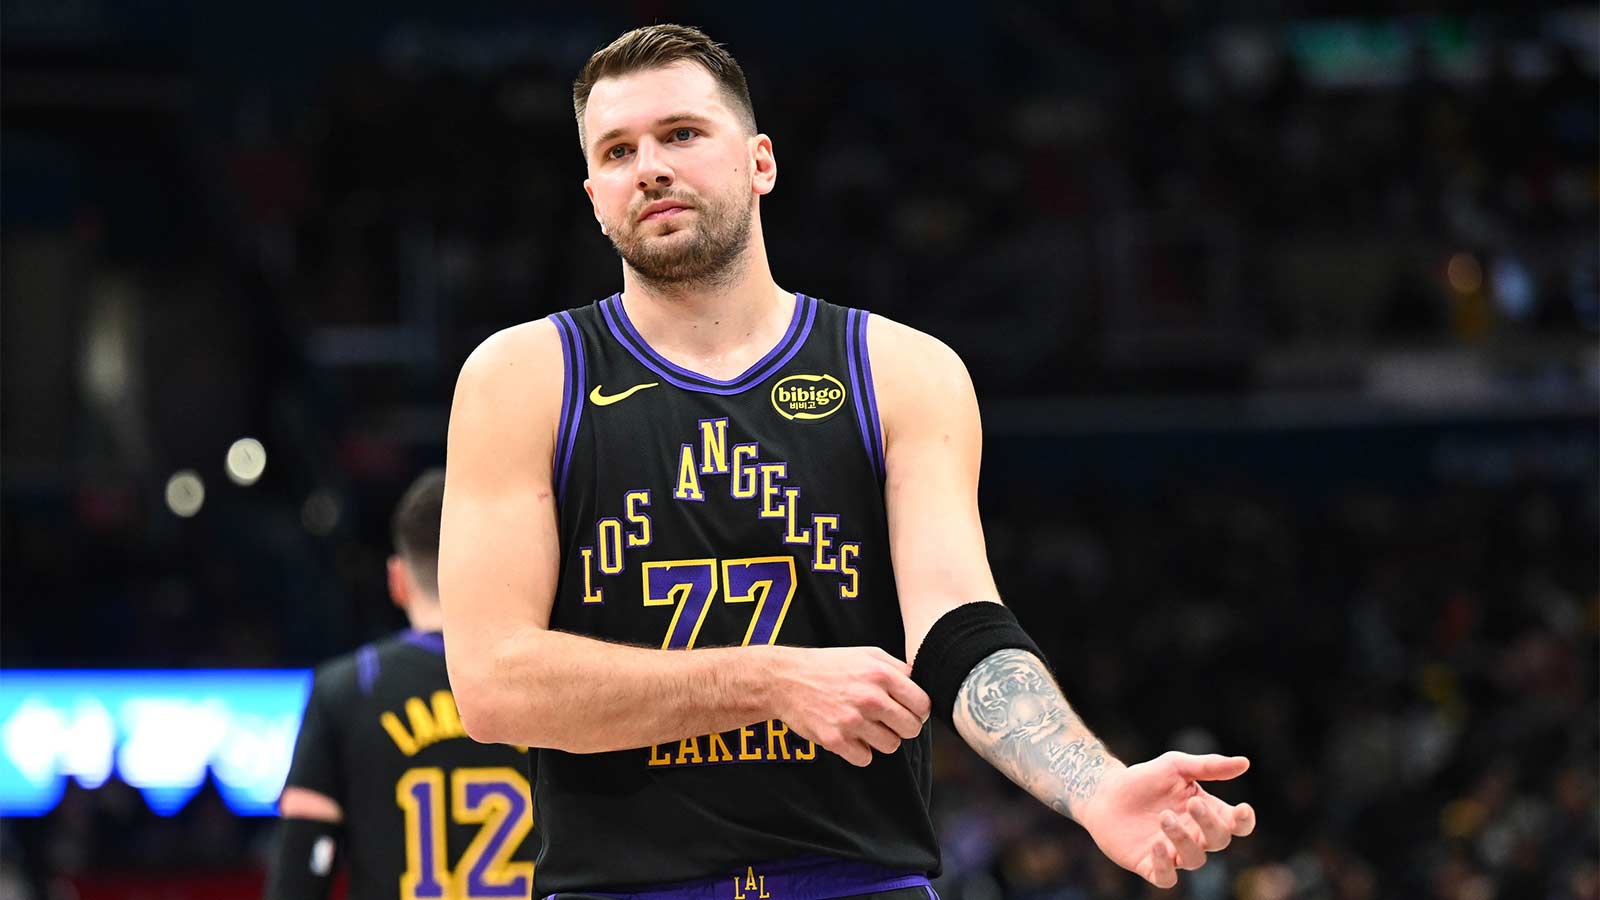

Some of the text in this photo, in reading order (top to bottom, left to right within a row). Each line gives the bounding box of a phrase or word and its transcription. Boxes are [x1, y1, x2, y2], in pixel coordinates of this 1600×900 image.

[778, 386, 842, 406] bibigo
[789, 401, 817, 410] 비비고
[580, 417, 861, 604] LOS ANGELES
[641, 555, 798, 650] 77
[396, 767, 534, 900] 12
[734, 866, 770, 900] LAL
